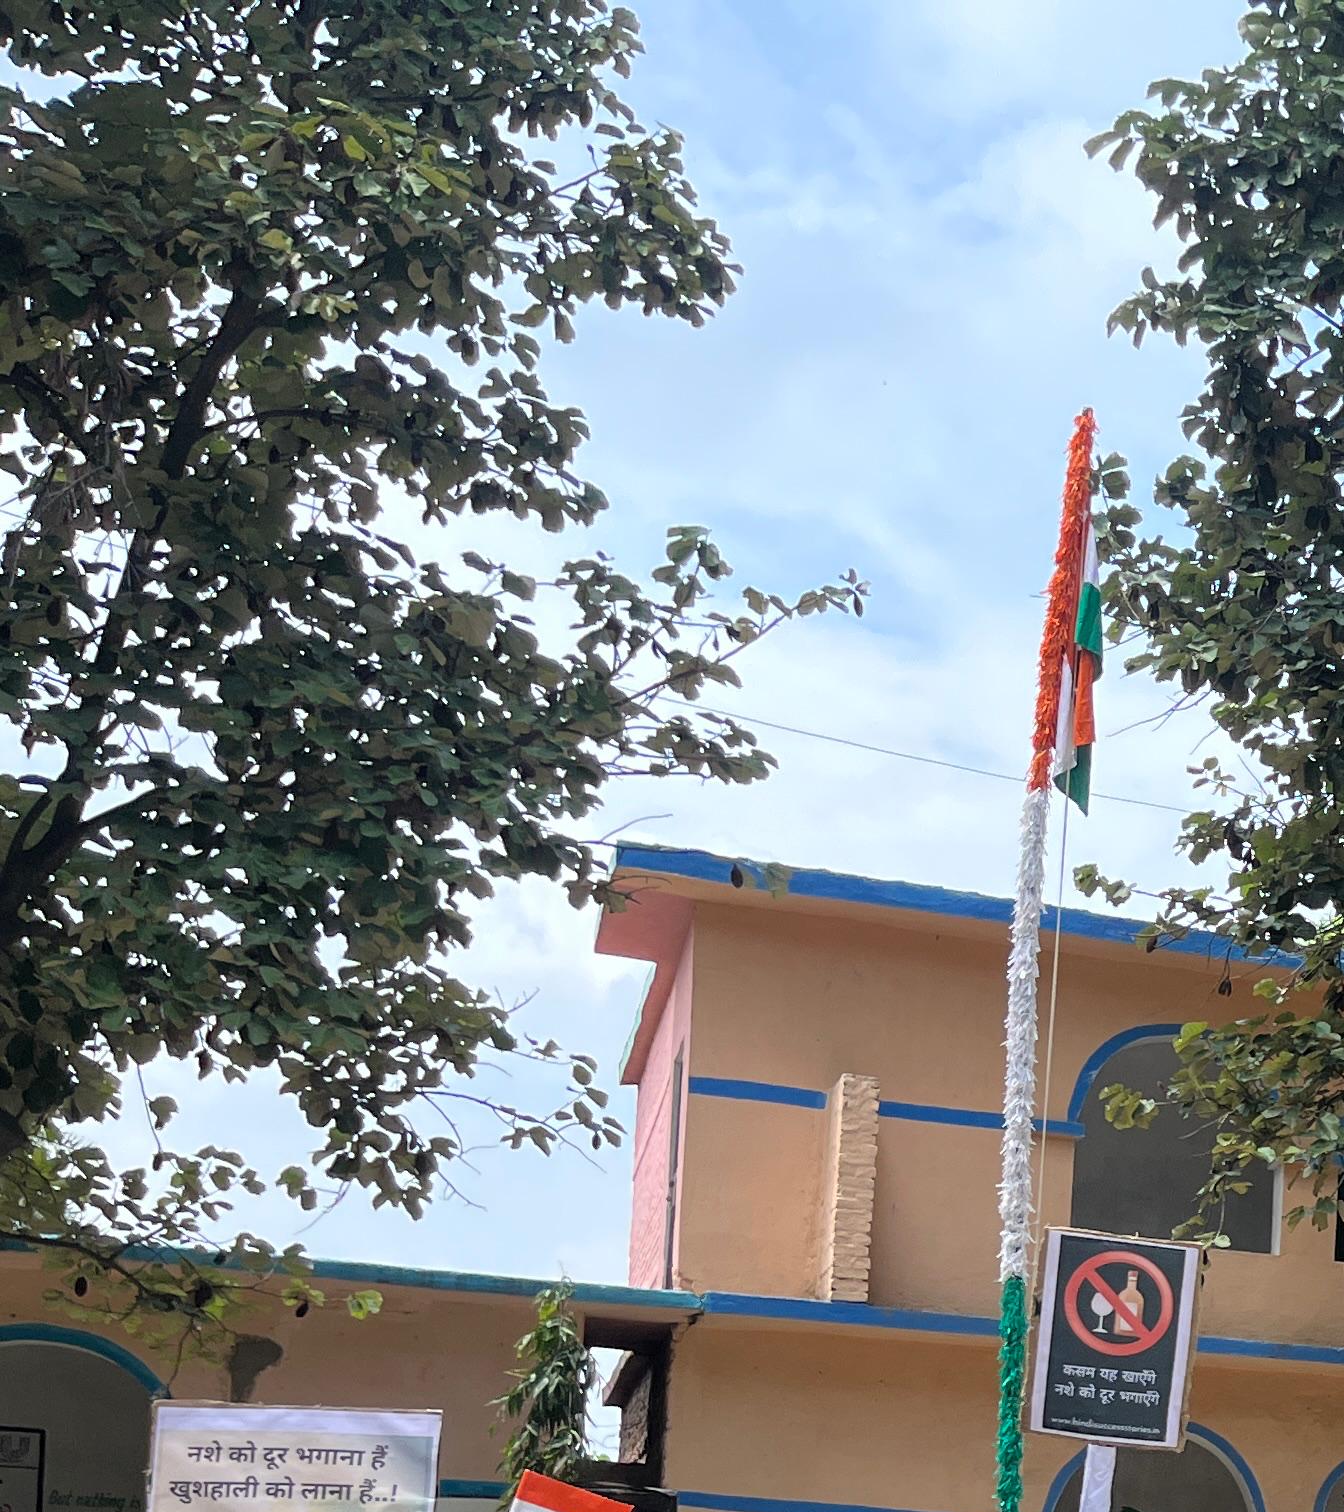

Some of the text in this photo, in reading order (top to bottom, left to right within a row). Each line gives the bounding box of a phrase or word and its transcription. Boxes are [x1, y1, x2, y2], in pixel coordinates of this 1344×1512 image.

[1062, 1364, 1096, 1378] कसम
[1100, 1368, 1118, 1382] यह
[1054, 1382, 1075, 1397] नशे
[1078, 1384, 1096, 1399] को
[1100, 1388, 1116, 1404] दूर
[187, 1440, 389, 1470] नशे को दूर भगाना हैं
[170, 1476, 259, 1504] खुशहाली
[265, 1476, 294, 1500] को
[301, 1483, 353, 1500] लाना
